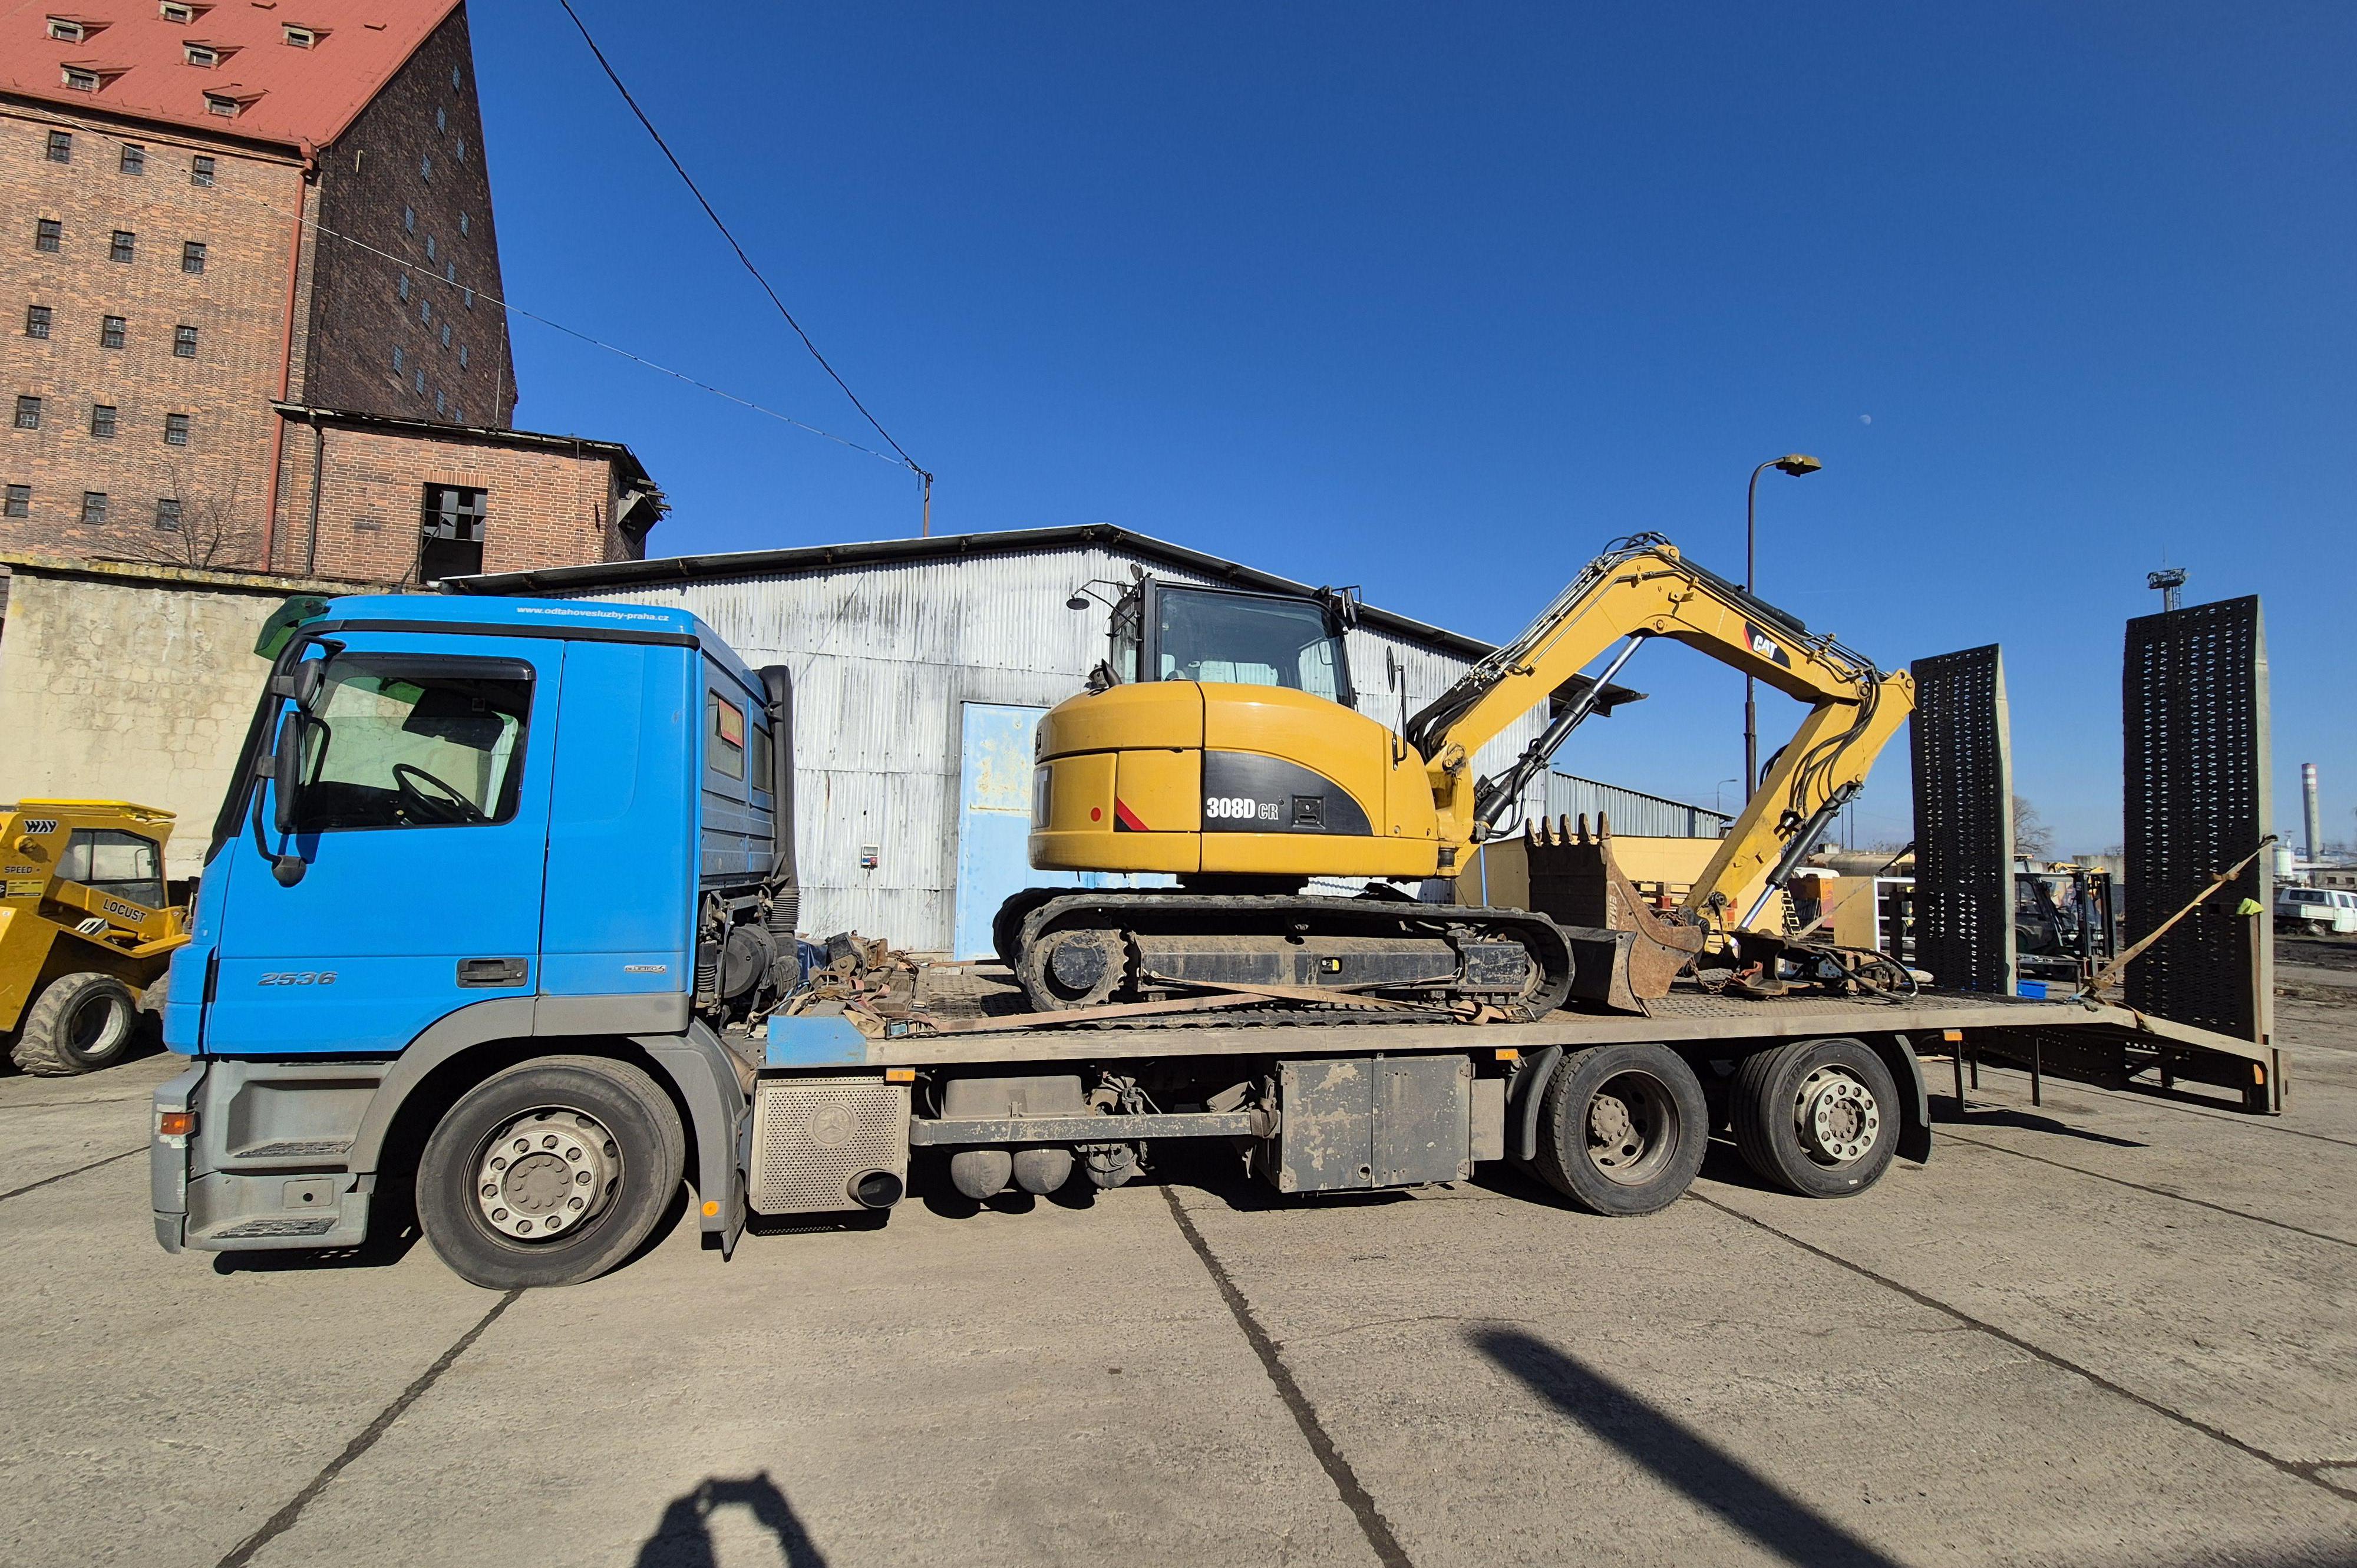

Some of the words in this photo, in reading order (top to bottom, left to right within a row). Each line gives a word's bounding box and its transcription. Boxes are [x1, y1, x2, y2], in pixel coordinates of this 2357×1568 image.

[517, 606, 669, 622] www.odtahovesluzby-praha.cz
[1753, 635, 1778, 659] CAT
[1206, 797, 1256, 818] 308D
[1258, 803, 1279, 820] CR
[24, 820, 58, 833] WAY
[103, 899, 146, 923] LOCUST
[258, 971, 338, 986] 2536
